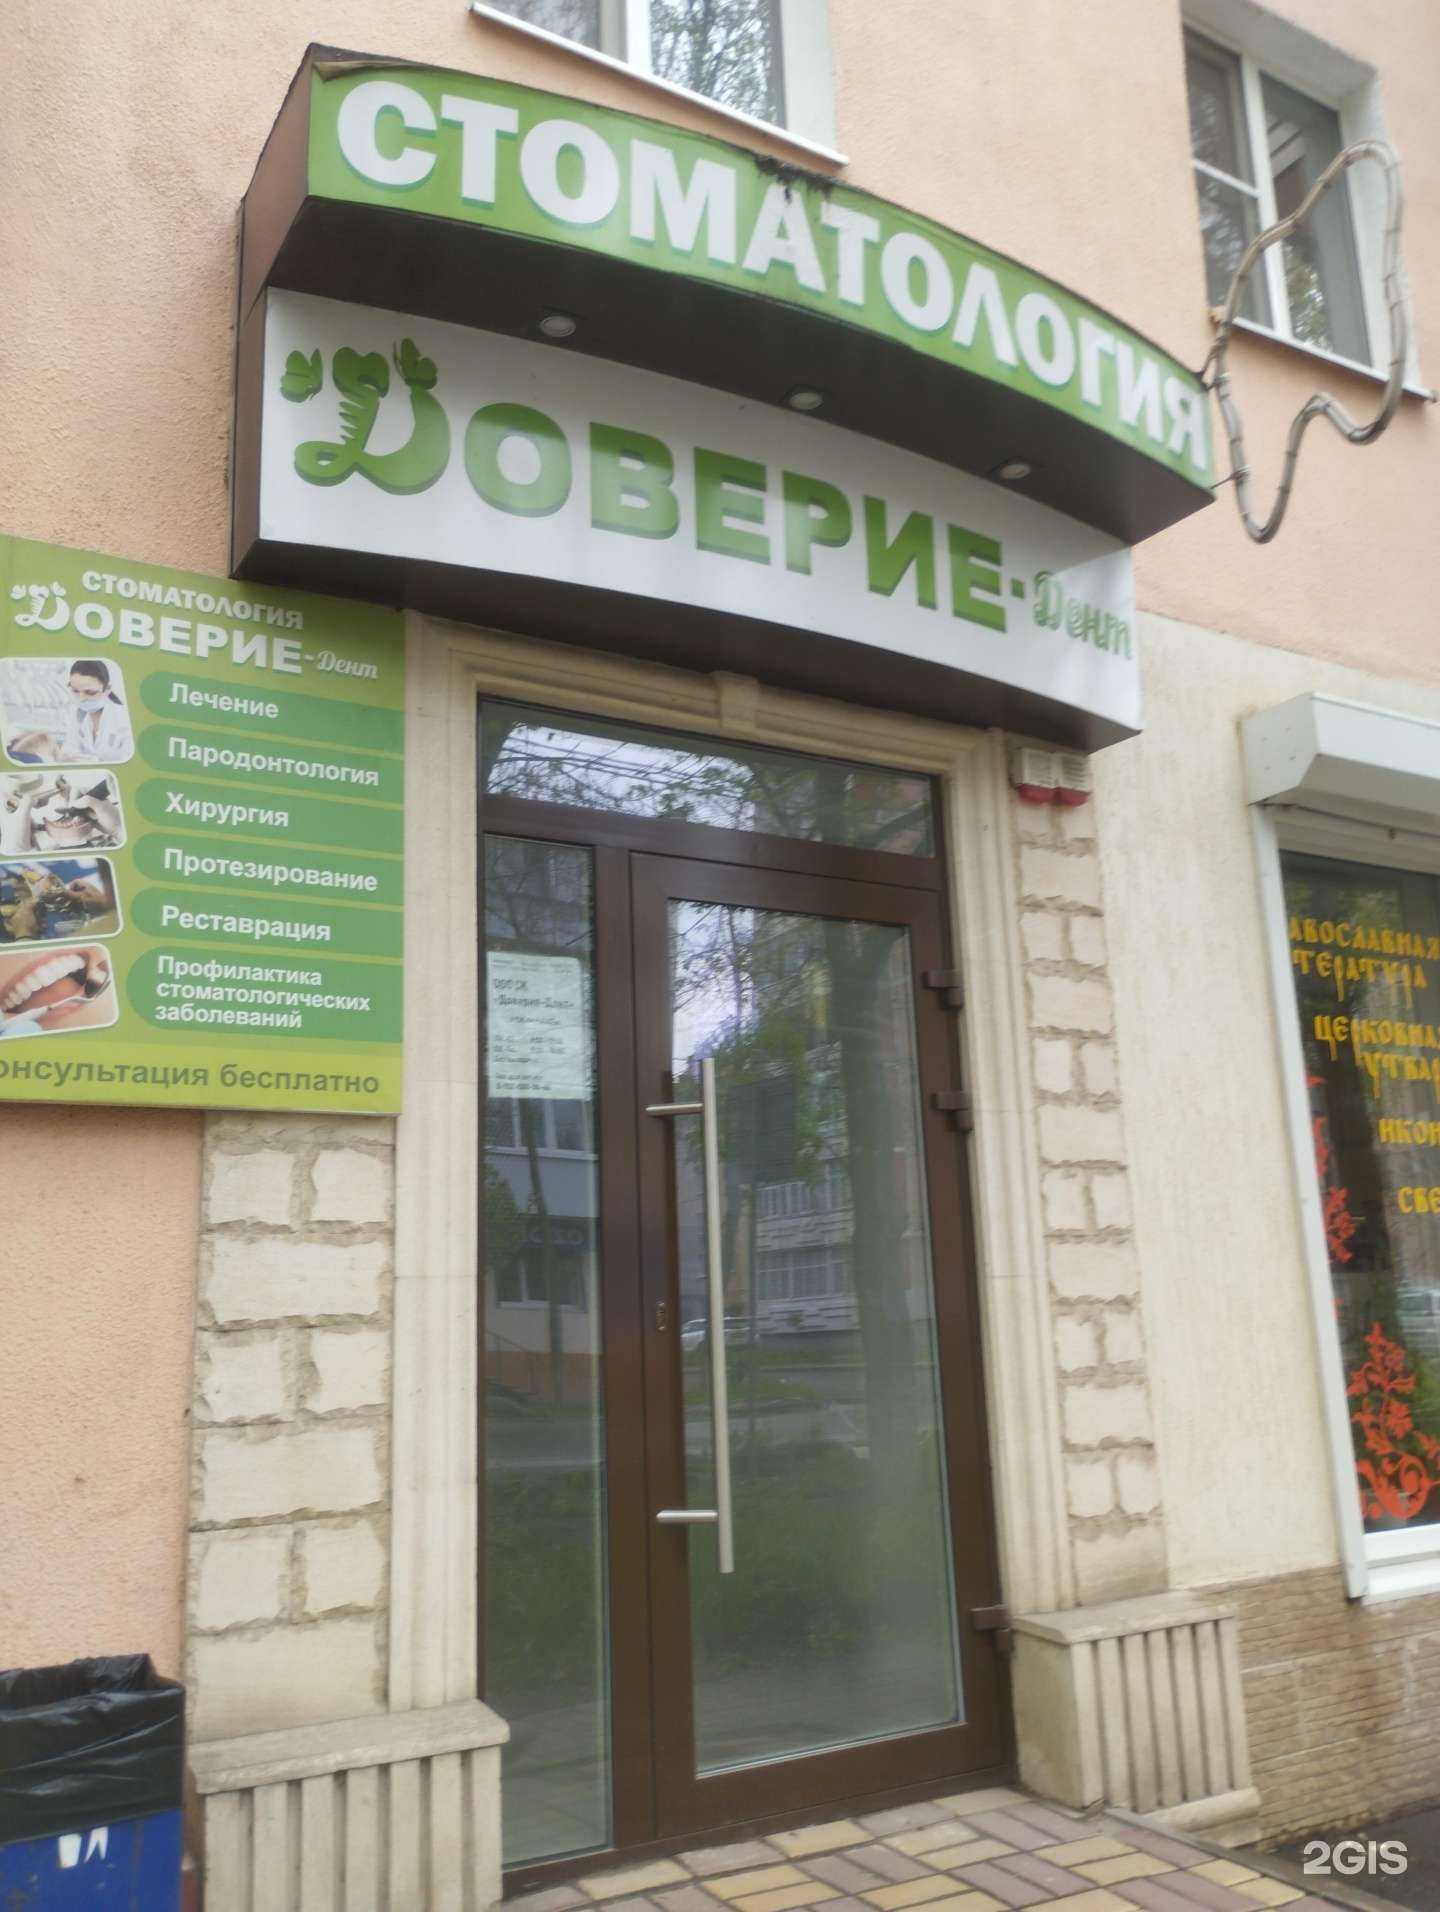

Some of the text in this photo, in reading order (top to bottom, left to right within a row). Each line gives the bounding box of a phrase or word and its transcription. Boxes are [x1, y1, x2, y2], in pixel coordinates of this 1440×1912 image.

[336, 81, 1209, 471] СТОМАТОЛОГИЯ
[82, 570, 303, 630] СТОМАТОЛОГИЯ
[169, 682, 279, 720] Лечение
[168, 737, 379, 786] Пародонтология
[165, 791, 289, 827] Хирургия
[163, 848, 378, 891] Протезирование
[161, 905, 331, 941] Реставрация
[157, 956, 322, 986] Профилактика
[154, 1002, 302, 1029] заболеваний
[155, 982, 371, 1012] стоматологических
[1313, 1015, 1440, 1067] ЦЕРКОВНА
[219, 1064, 380, 1094] бесплатно
